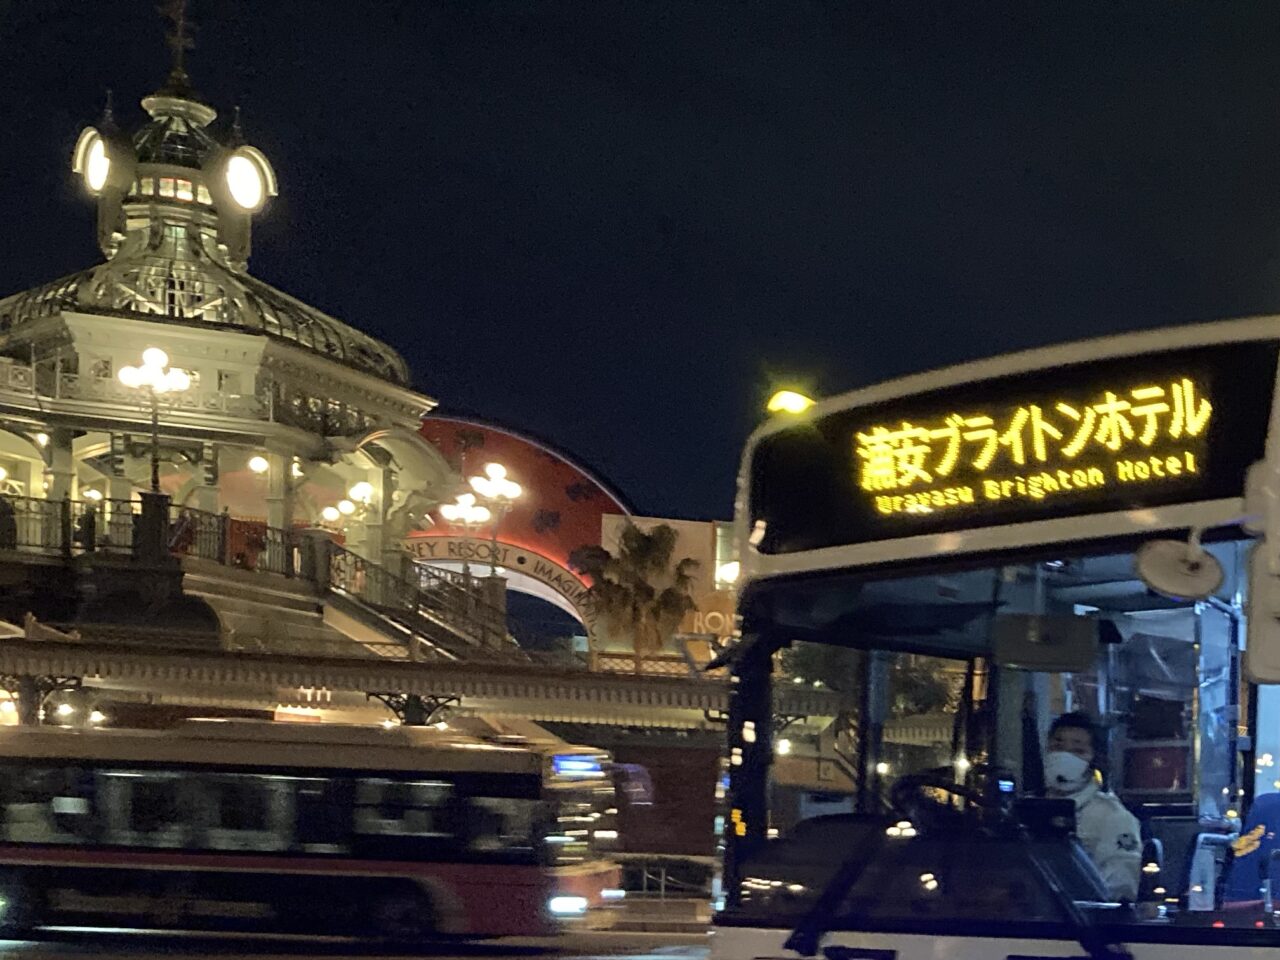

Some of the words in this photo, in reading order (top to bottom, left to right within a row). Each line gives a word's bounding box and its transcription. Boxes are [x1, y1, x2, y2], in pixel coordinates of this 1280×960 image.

[856, 378, 1212, 492] 浦安ブライトンホテル
[983, 466, 1105, 500] Brighton
[1116, 451, 1197, 482] Hotel
[448, 541, 510, 564] RESORT
